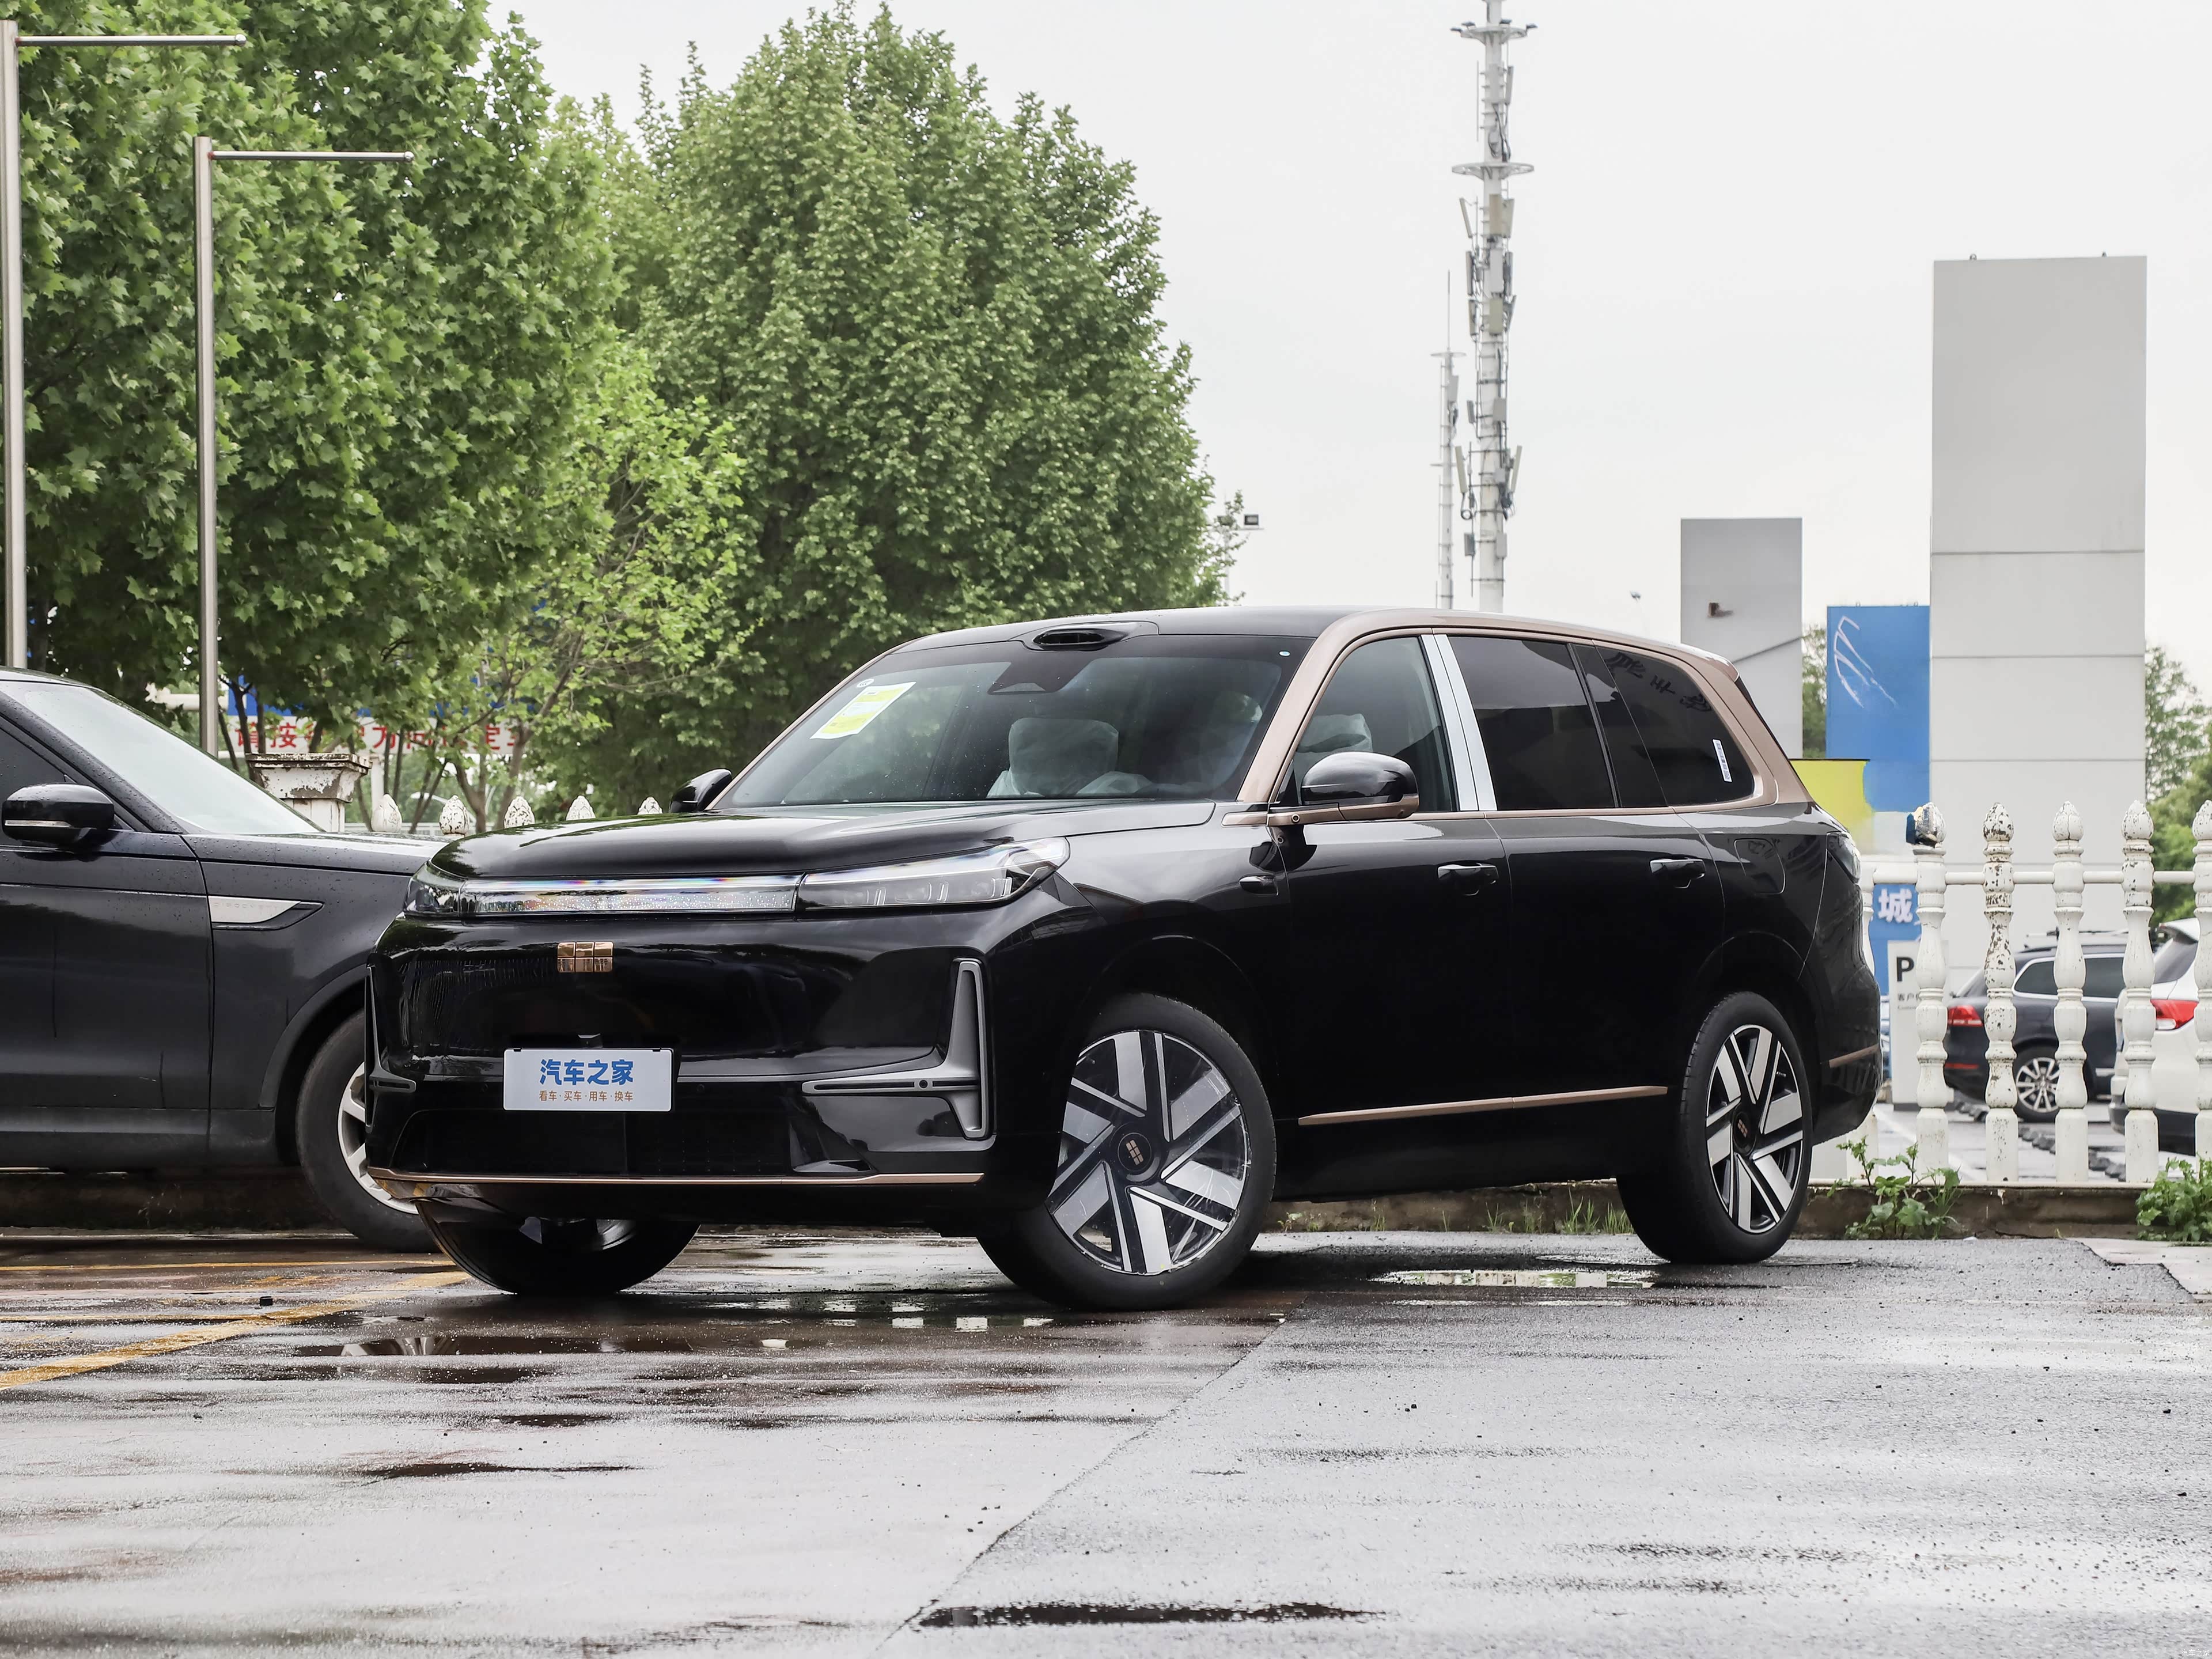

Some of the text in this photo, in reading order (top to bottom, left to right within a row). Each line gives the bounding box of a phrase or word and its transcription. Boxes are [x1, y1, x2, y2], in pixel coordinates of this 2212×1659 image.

[1896, 956, 1914, 982] P
[539, 1059, 633, 1085] 汽车之家
